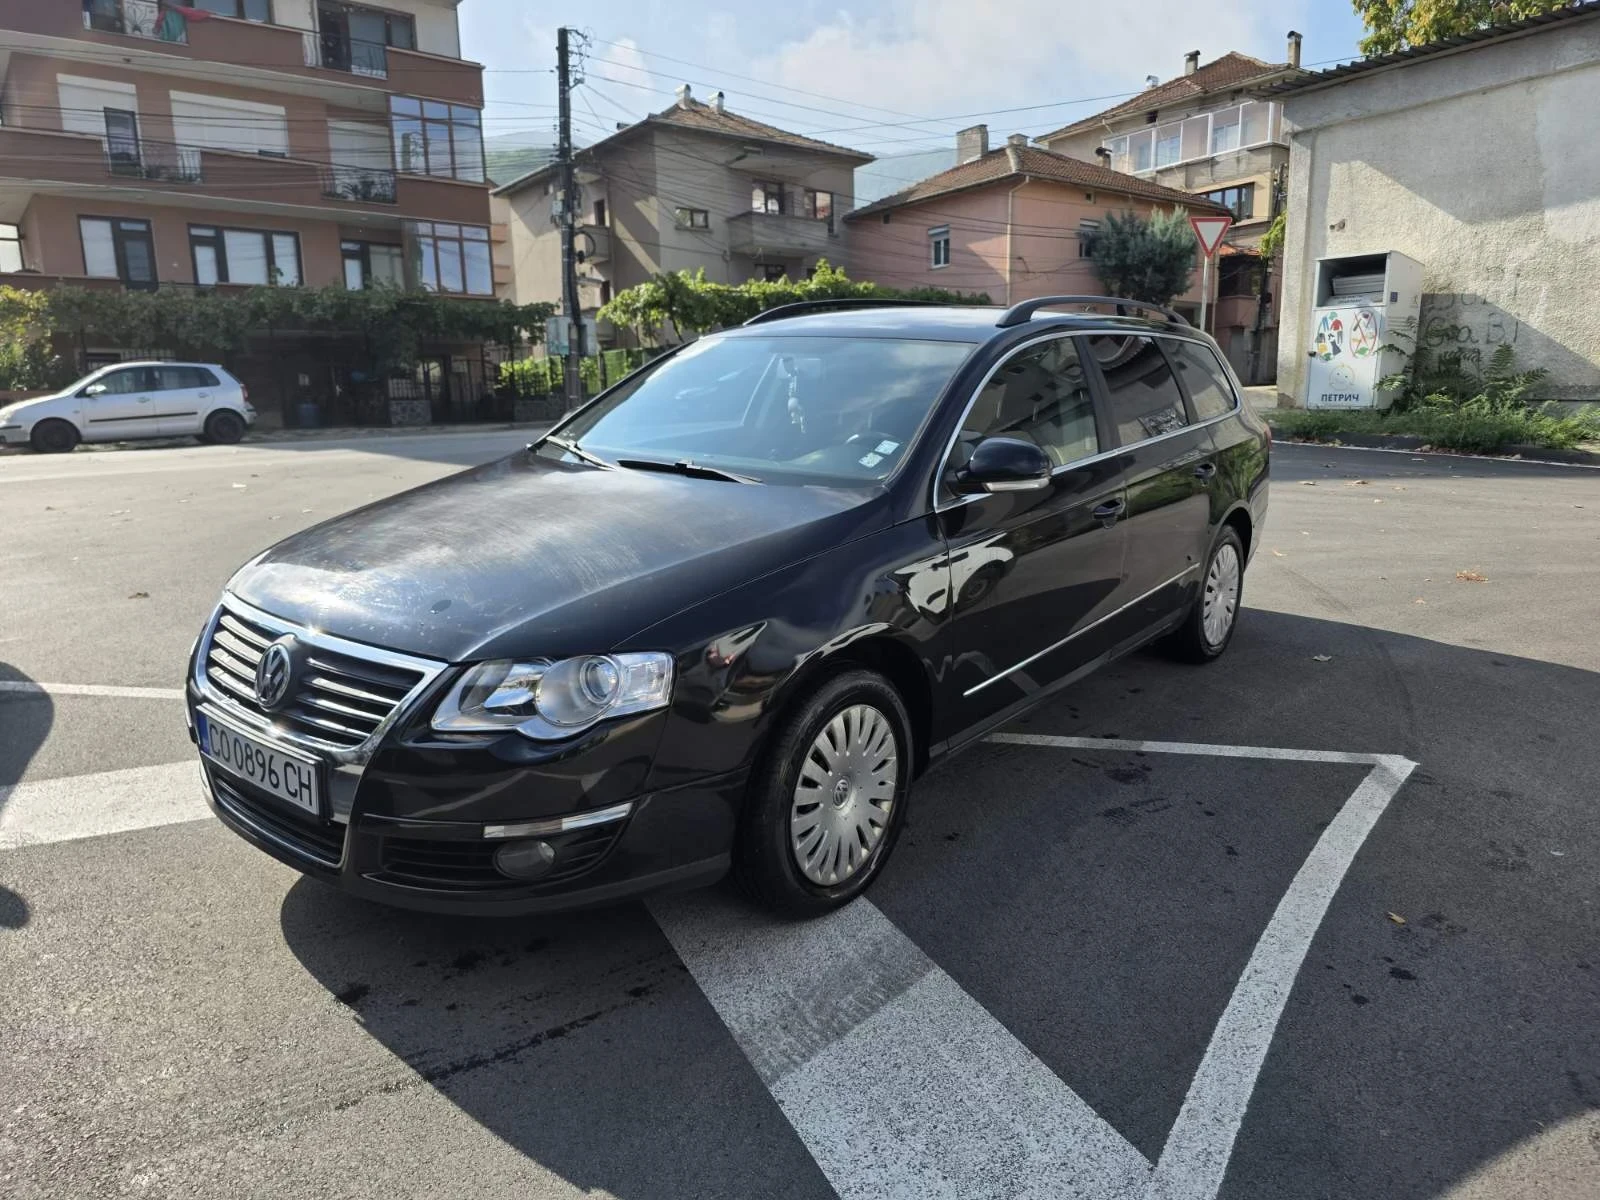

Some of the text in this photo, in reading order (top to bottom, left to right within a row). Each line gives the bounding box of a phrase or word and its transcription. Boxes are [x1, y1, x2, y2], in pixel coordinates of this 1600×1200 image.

[1320, 393, 1360, 402] ПЕТРИЧ
[210, 725, 313, 807] CO 0896 CH
